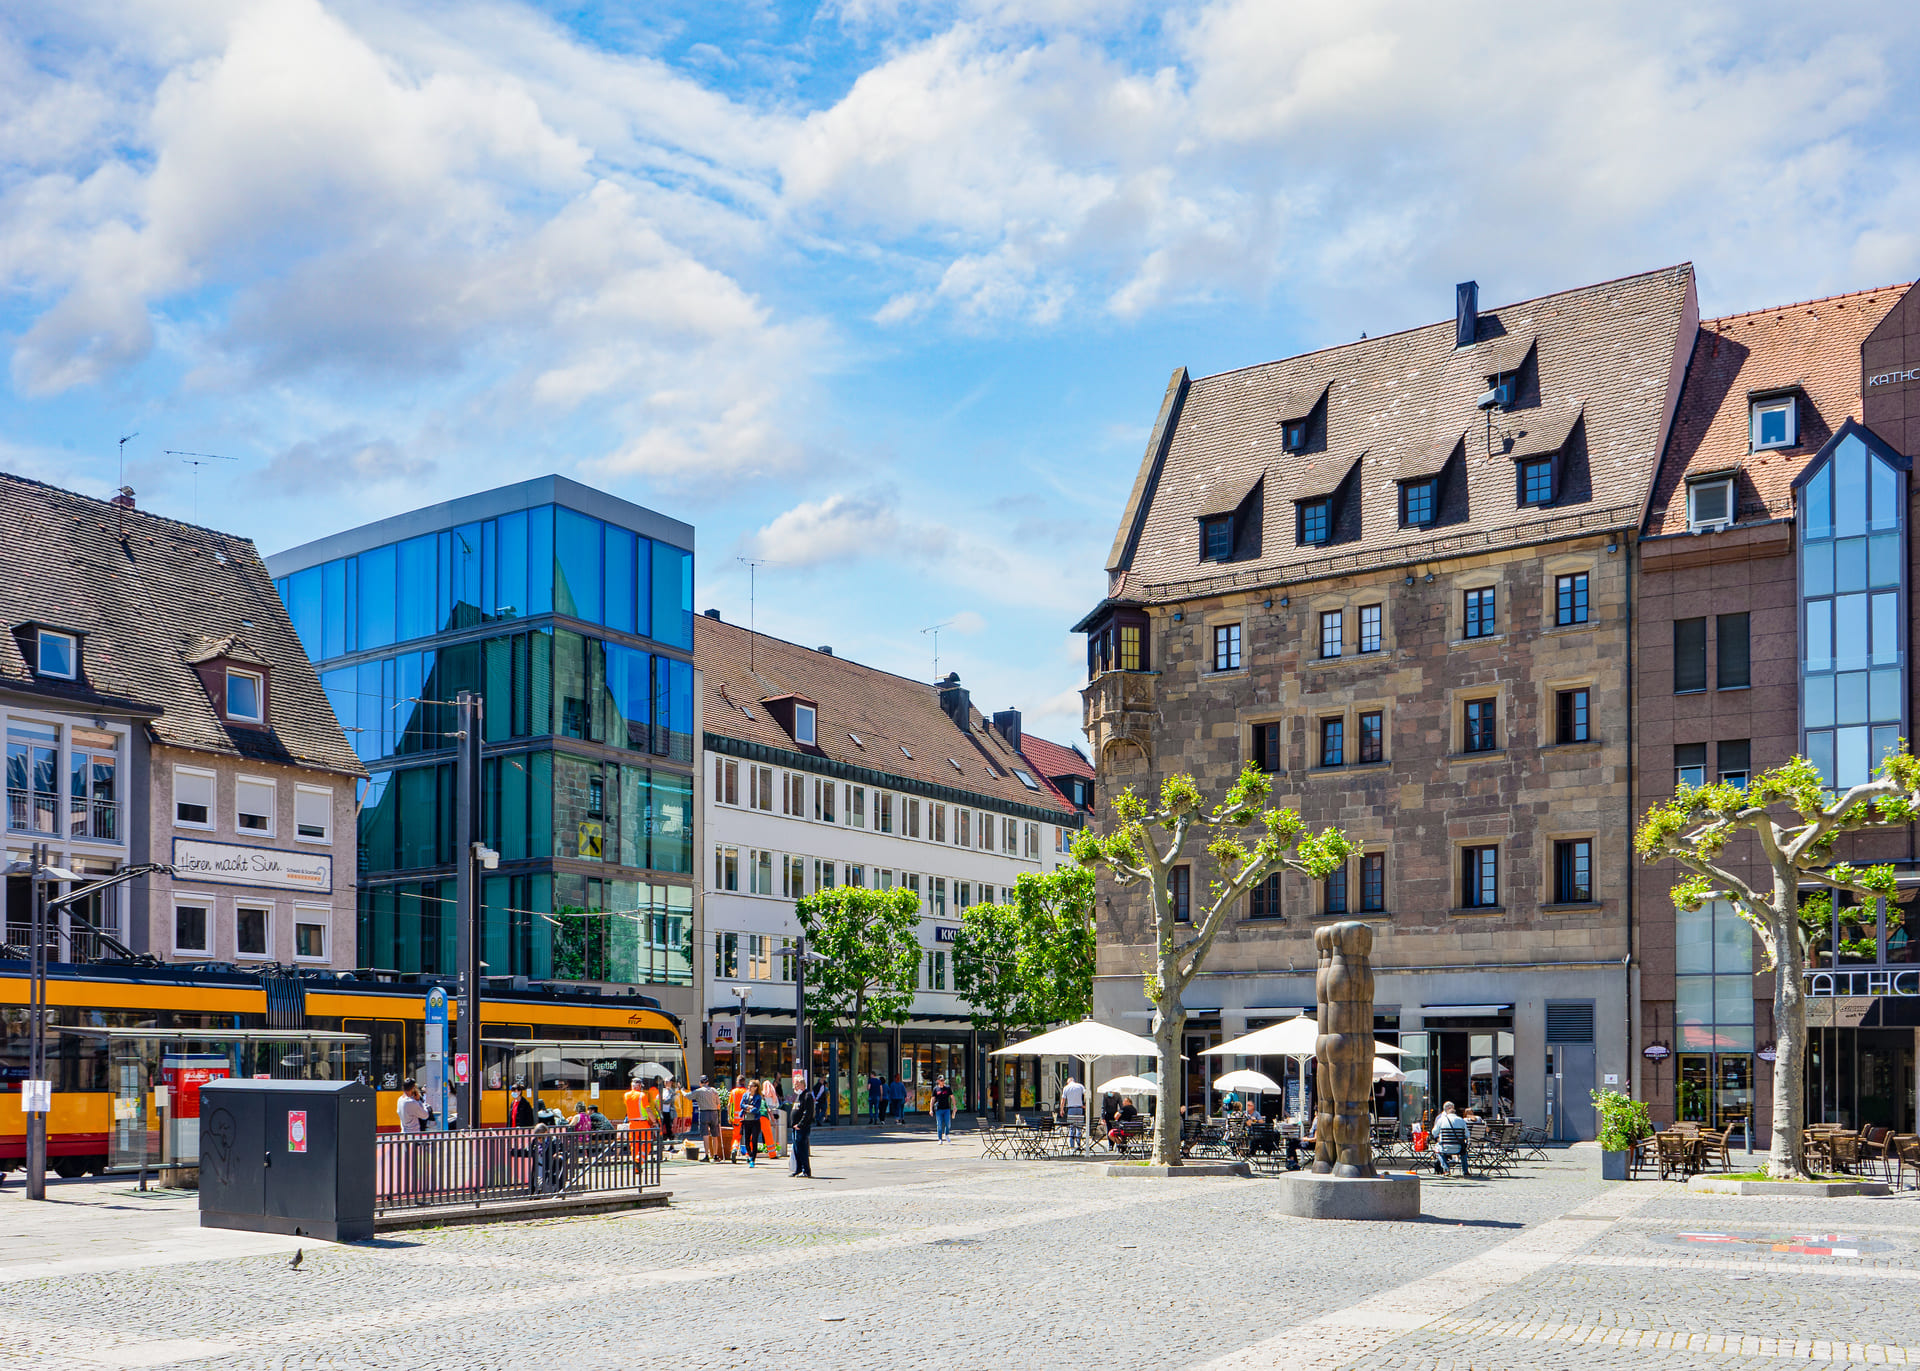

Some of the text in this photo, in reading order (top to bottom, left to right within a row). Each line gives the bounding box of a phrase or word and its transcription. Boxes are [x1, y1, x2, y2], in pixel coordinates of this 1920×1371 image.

[178, 851, 283, 872] Hören macht Sinn.
[717, 1024, 732, 1037] dm
